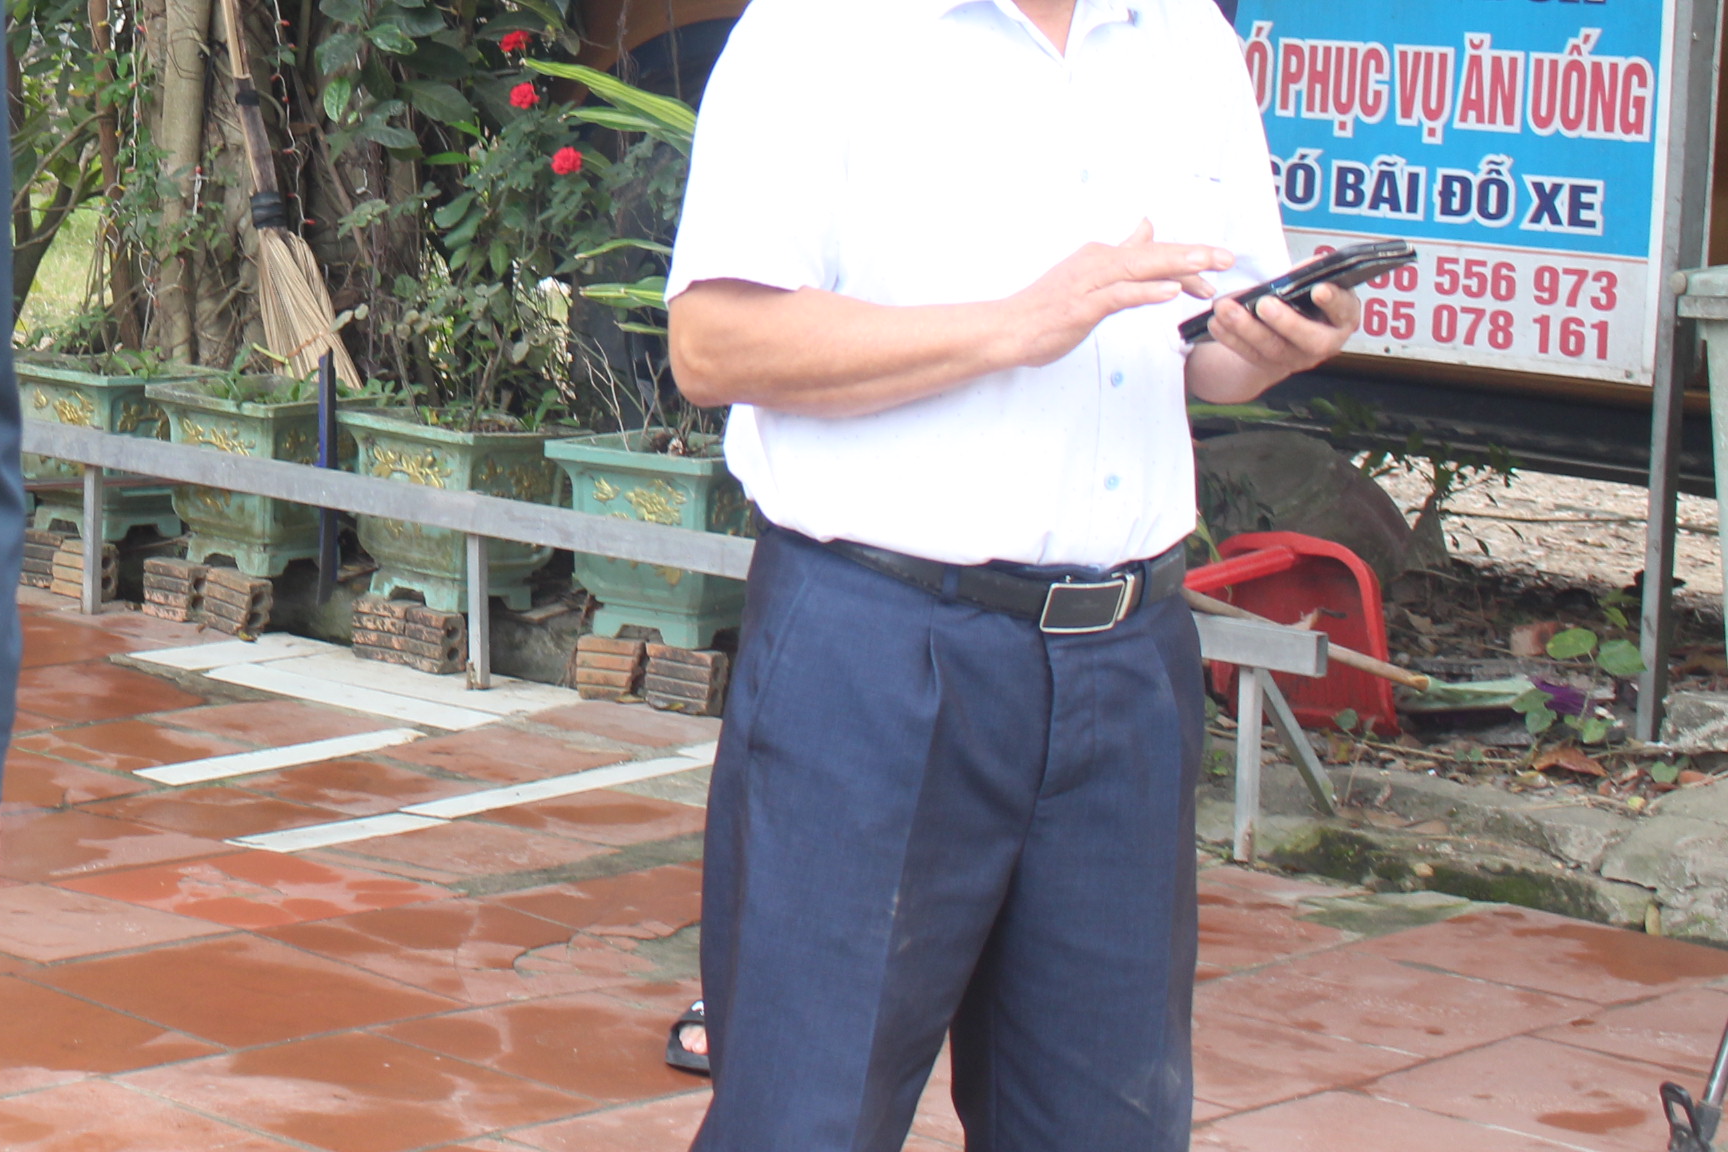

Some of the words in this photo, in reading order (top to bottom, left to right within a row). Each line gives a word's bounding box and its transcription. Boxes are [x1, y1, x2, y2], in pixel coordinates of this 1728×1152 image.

[1244, 22, 1273, 115] Ó
[1277, 41, 1387, 134] PHỤC
[1396, 48, 1451, 141] VỤ
[1456, 36, 1520, 128] ĂN
[1528, 31, 1651, 138] UỐNG
[1332, 157, 1424, 217] BÃI
[1435, 155, 1513, 224] ĐỖ
[1528, 179, 1600, 231] XE
[1433, 256, 1517, 302] 556
[1532, 264, 1618, 312] 973
[1361, 297, 1416, 341] 65
[1431, 304, 1514, 351] 078
[1532, 314, 1609, 360] 161
